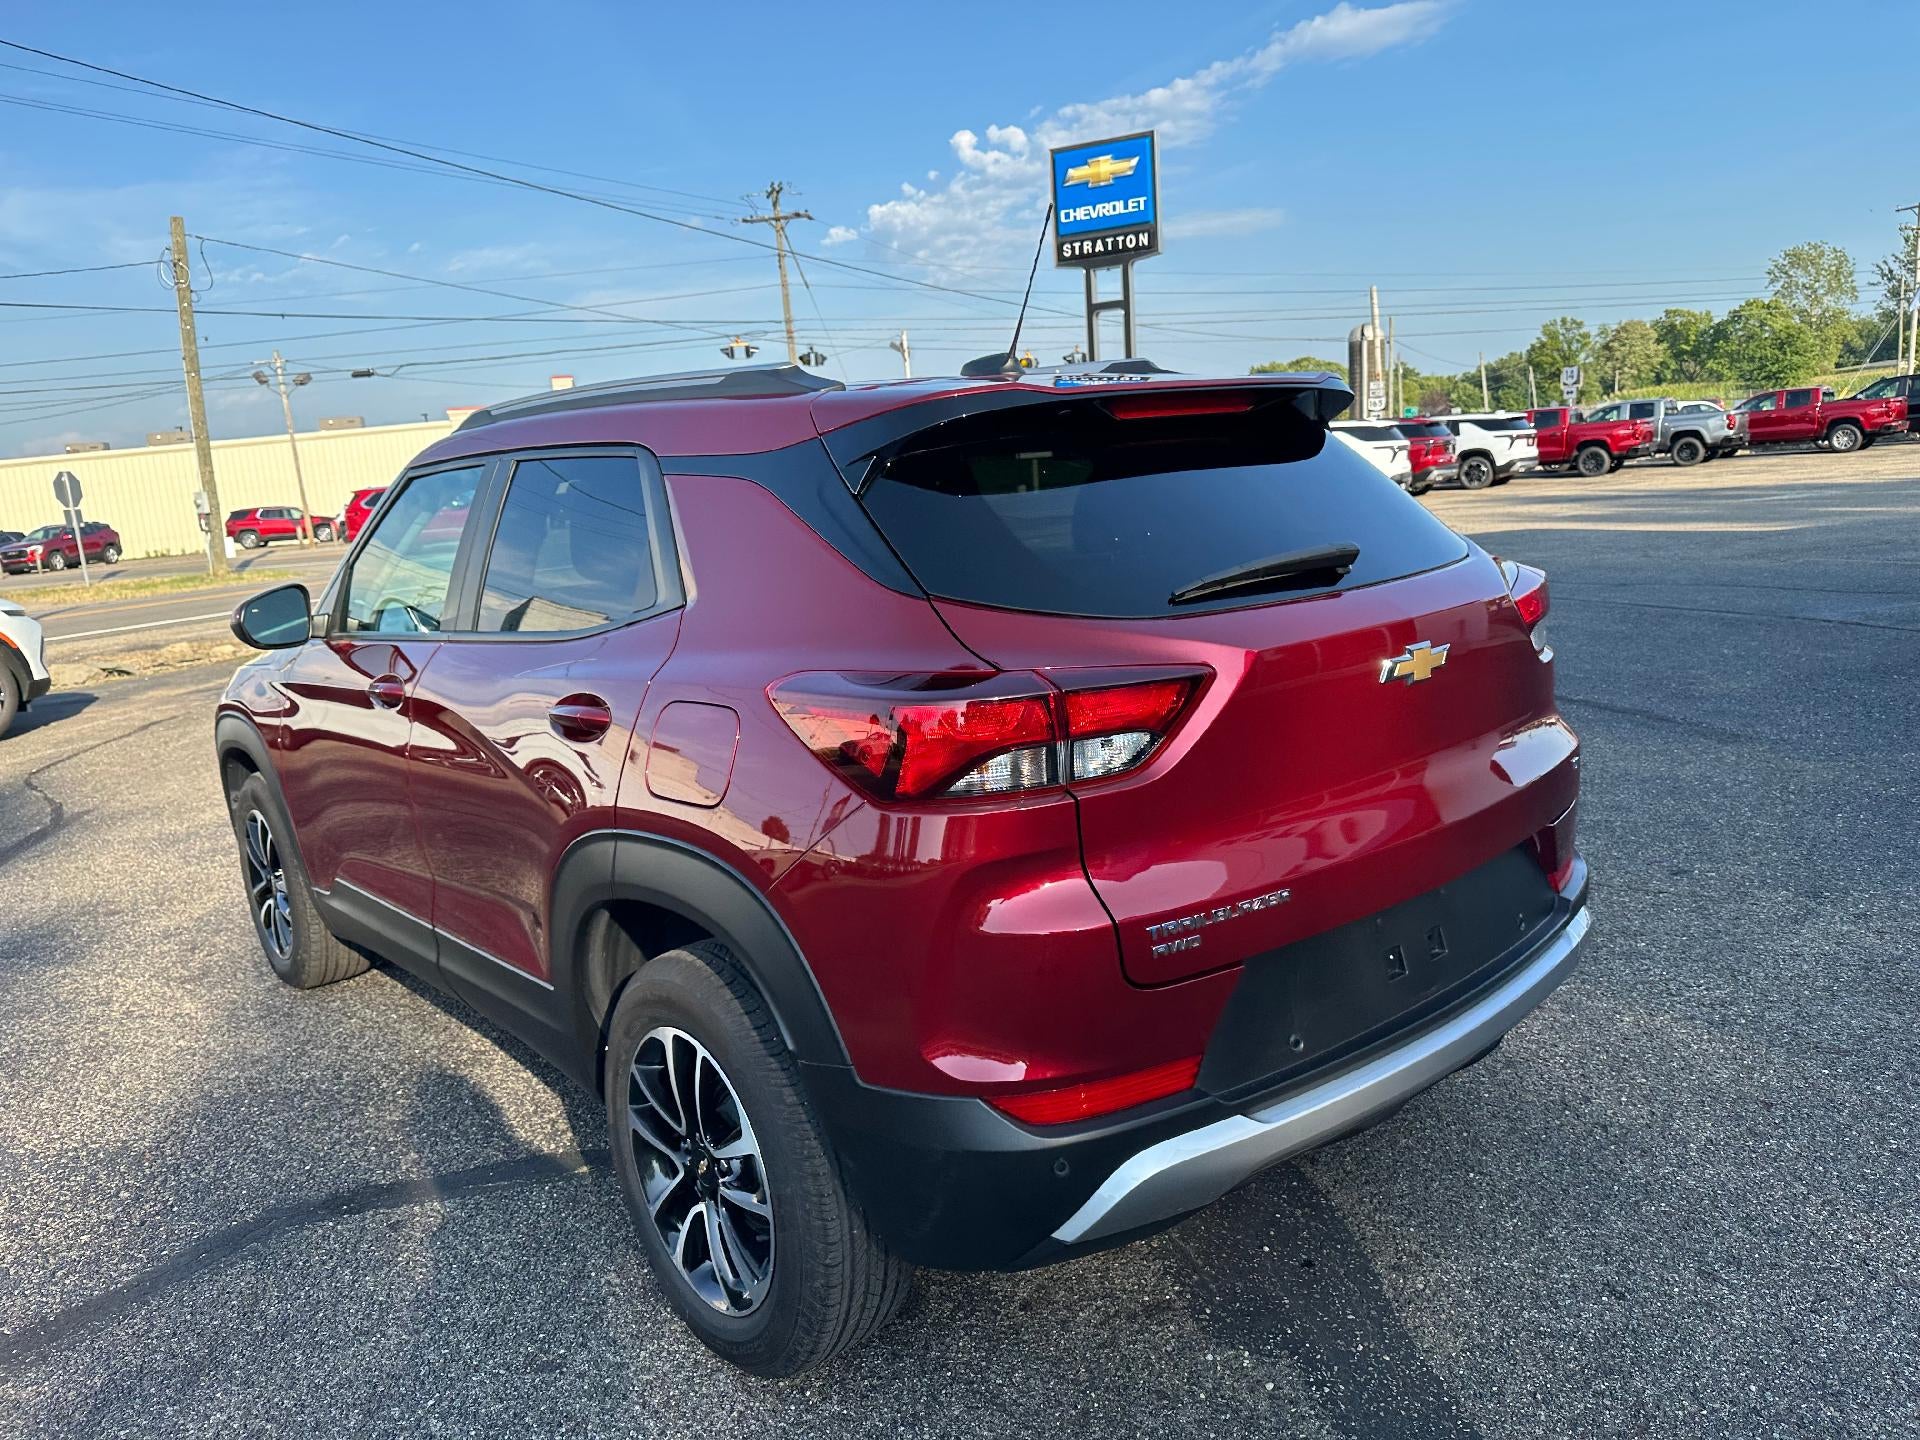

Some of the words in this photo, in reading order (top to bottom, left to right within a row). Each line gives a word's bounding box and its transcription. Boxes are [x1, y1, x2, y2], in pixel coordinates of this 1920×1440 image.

[1060, 197, 1147, 222] CHEVROLET
[1062, 232, 1149, 257] STRATTON
[1145, 888, 1292, 940] TRAILBLAZER
[1151, 934, 1202, 959] AWD
